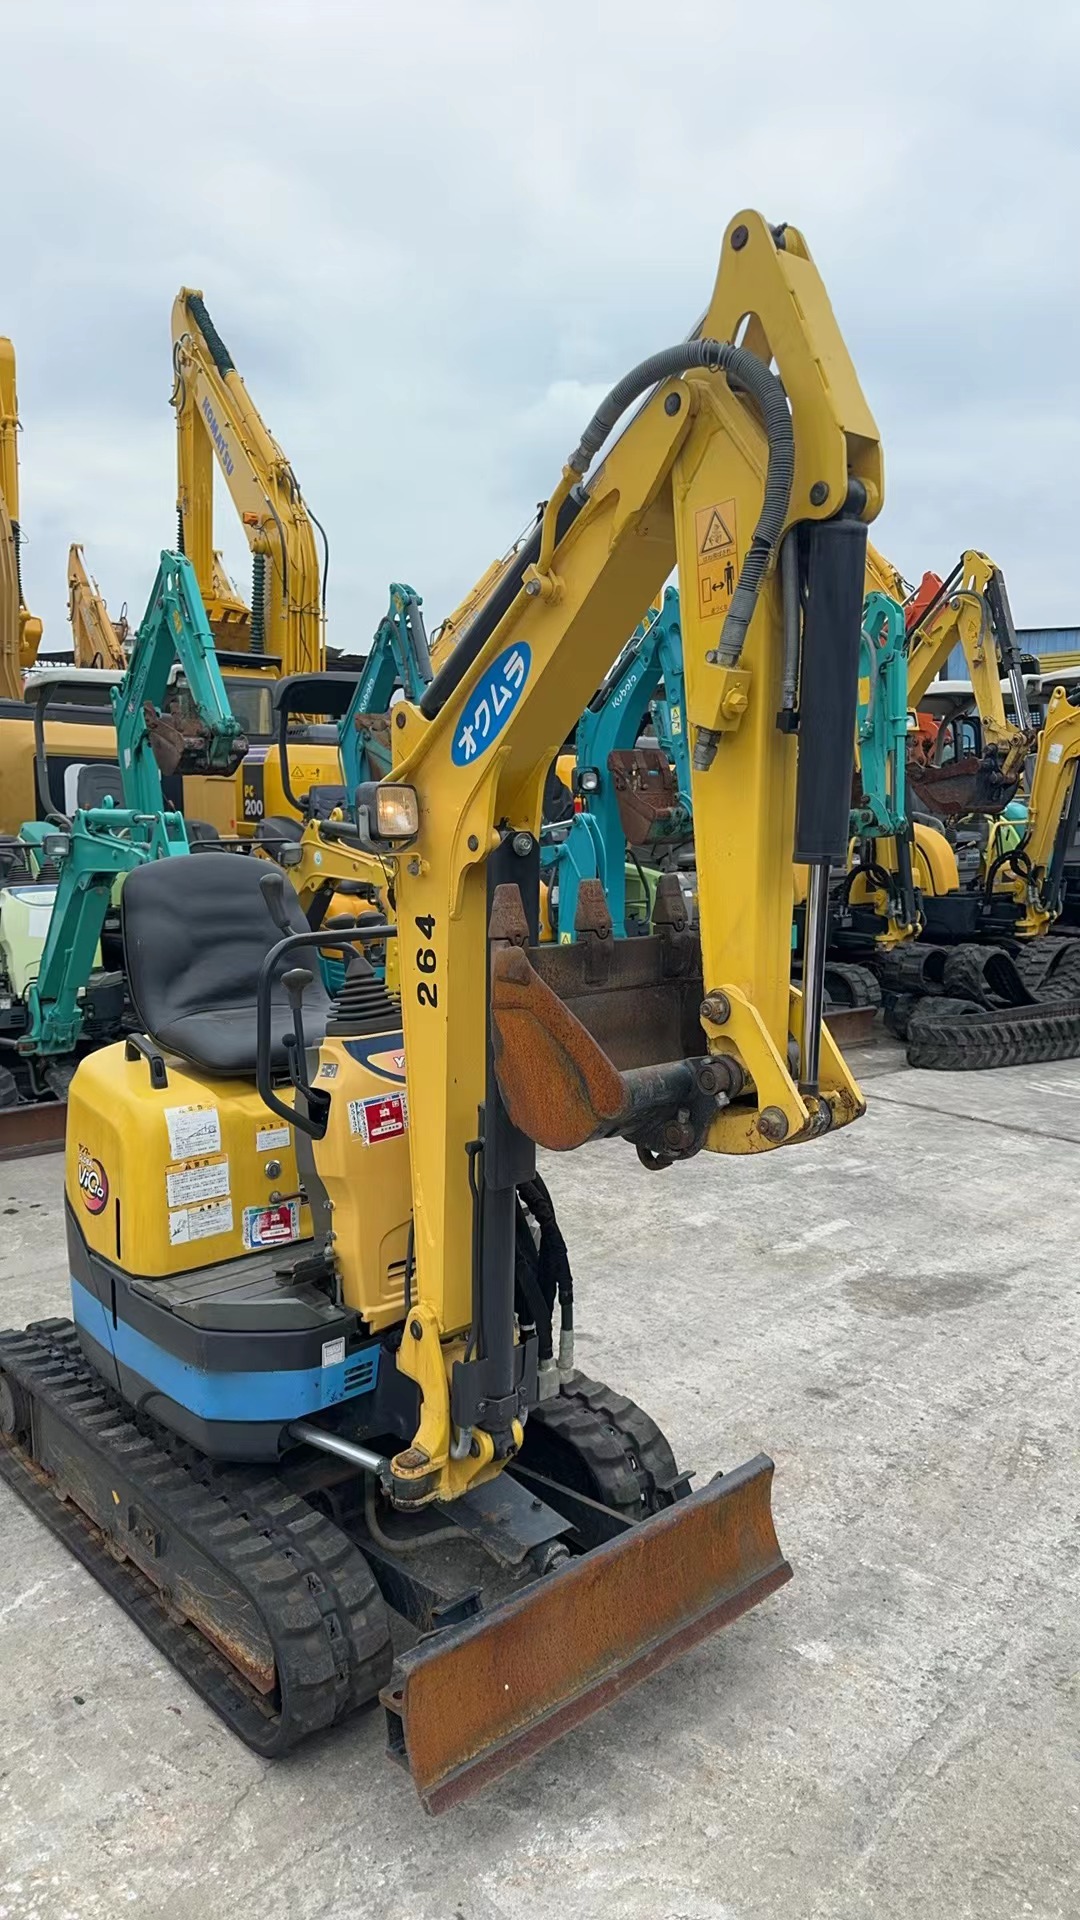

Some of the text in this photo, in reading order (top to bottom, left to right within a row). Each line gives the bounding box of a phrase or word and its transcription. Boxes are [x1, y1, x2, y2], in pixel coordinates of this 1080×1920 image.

[202, 396, 234, 476] KOMATSU
[359, 678, 375, 713] Kubota
[458, 650, 525, 760] オクムラ
[611, 674, 637, 709] Kubota
[244, 784, 255, 798] PC
[244, 799, 263, 816] 200
[415, 914, 438, 1009] 264
